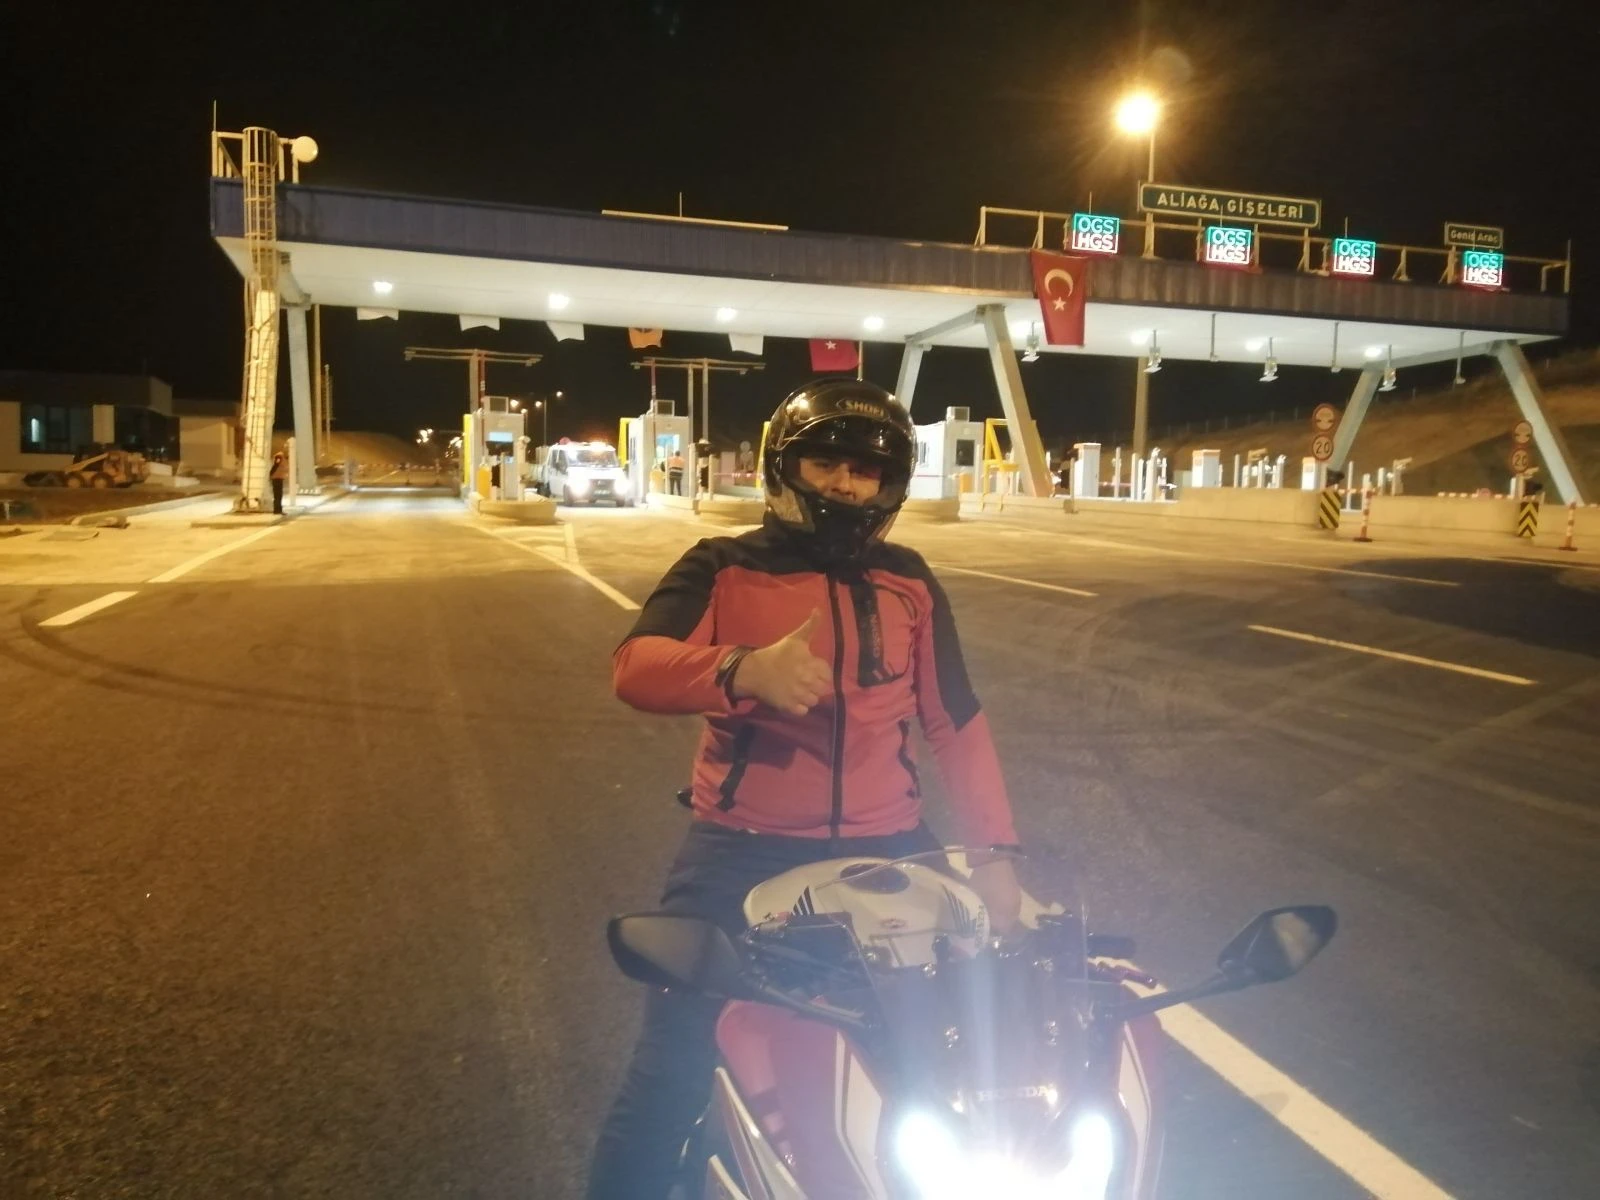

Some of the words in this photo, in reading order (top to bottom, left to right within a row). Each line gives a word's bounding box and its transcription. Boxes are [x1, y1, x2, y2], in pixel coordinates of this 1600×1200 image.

[1157, 192, 1220, 212] ALİAĞA
[1227, 198, 1304, 219] GİŞELERİ
[1078, 216, 1114, 235] OGS
[1078, 232, 1114, 250] HGS
[1211, 229, 1246, 246] OGS
[1211, 243, 1246, 261] HGS
[1338, 241, 1371, 257] OGS
[1338, 255, 1371, 272] HGS
[1468, 253, 1499, 269] OGS
[1467, 267, 1499, 283] HGS
[1315, 441, 1330, 454] 20
